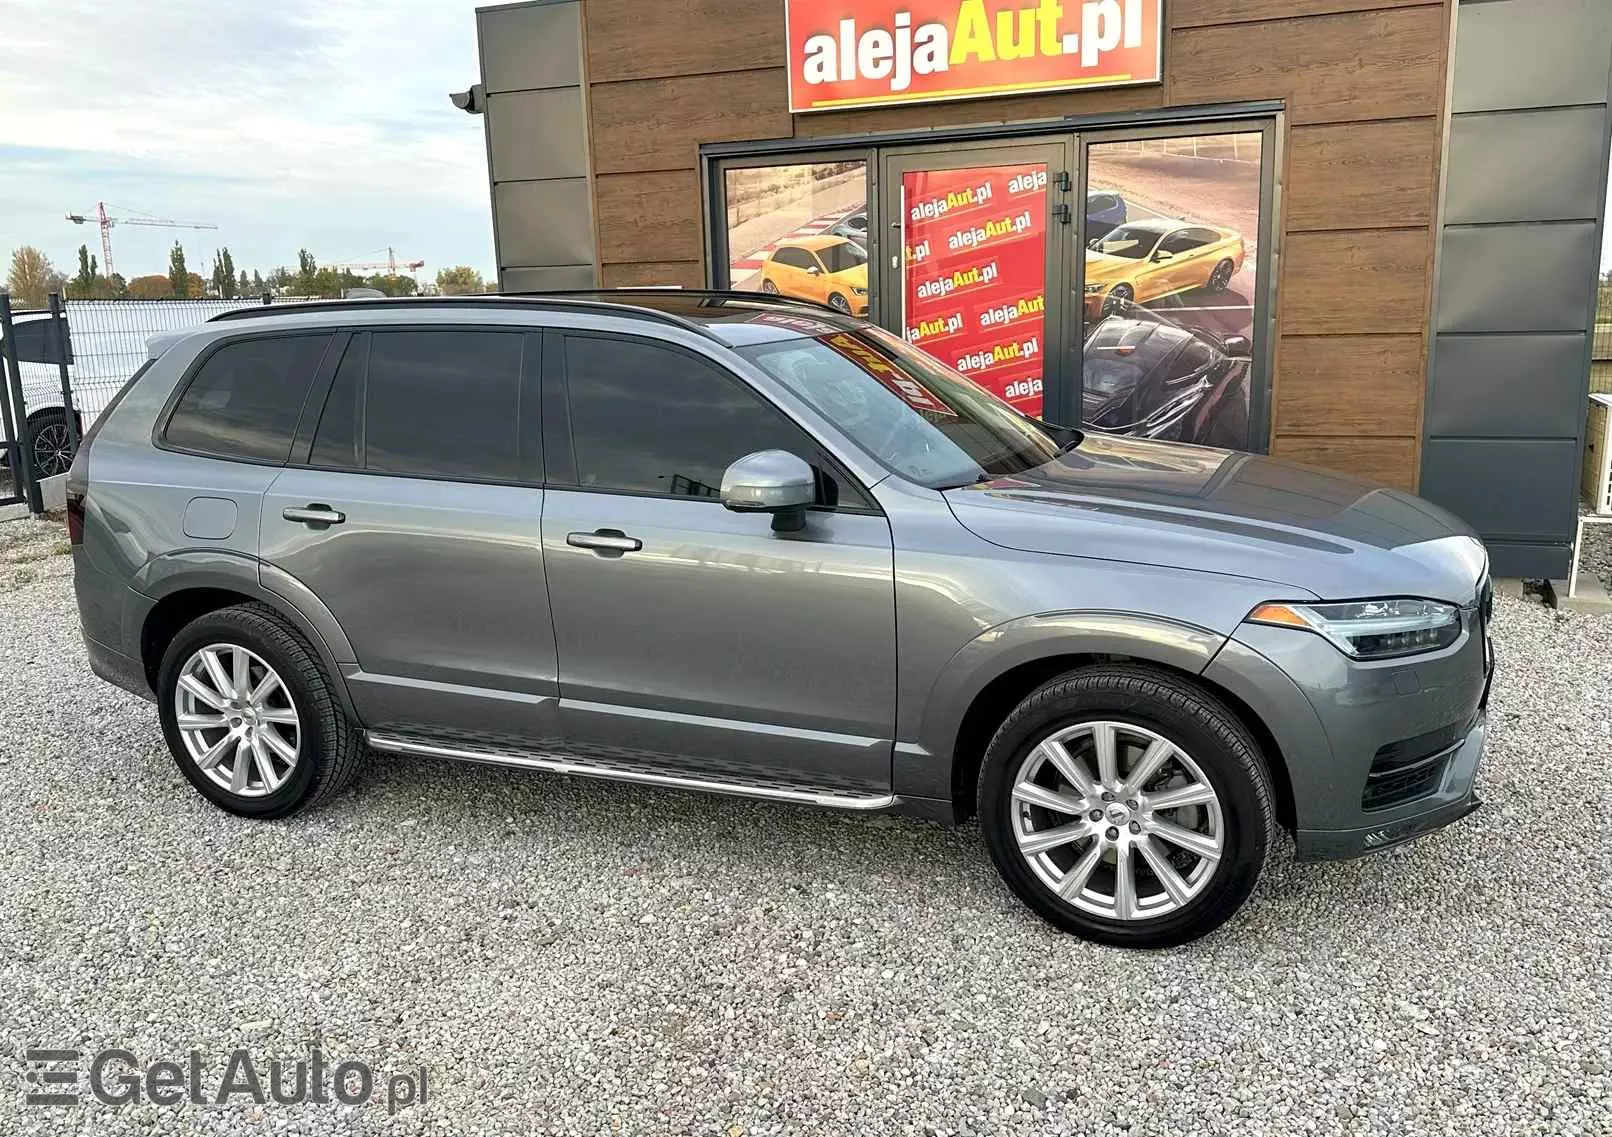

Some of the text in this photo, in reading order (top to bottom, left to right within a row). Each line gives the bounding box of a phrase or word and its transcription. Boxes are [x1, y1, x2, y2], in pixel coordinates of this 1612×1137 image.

[803, 0, 1143, 91] alejaAut.pl
[1008, 171, 1047, 193] aleja
[911, 182, 992, 220] alejaAut.pl
[948, 211, 1031, 249] alejaAut.pl
[917, 262, 998, 298] alejaAut.pl
[980, 295, 1044, 326] alejaAut
[957, 337, 1038, 371] alejaAut.pl
[1005, 378, 1043, 398] aleja
